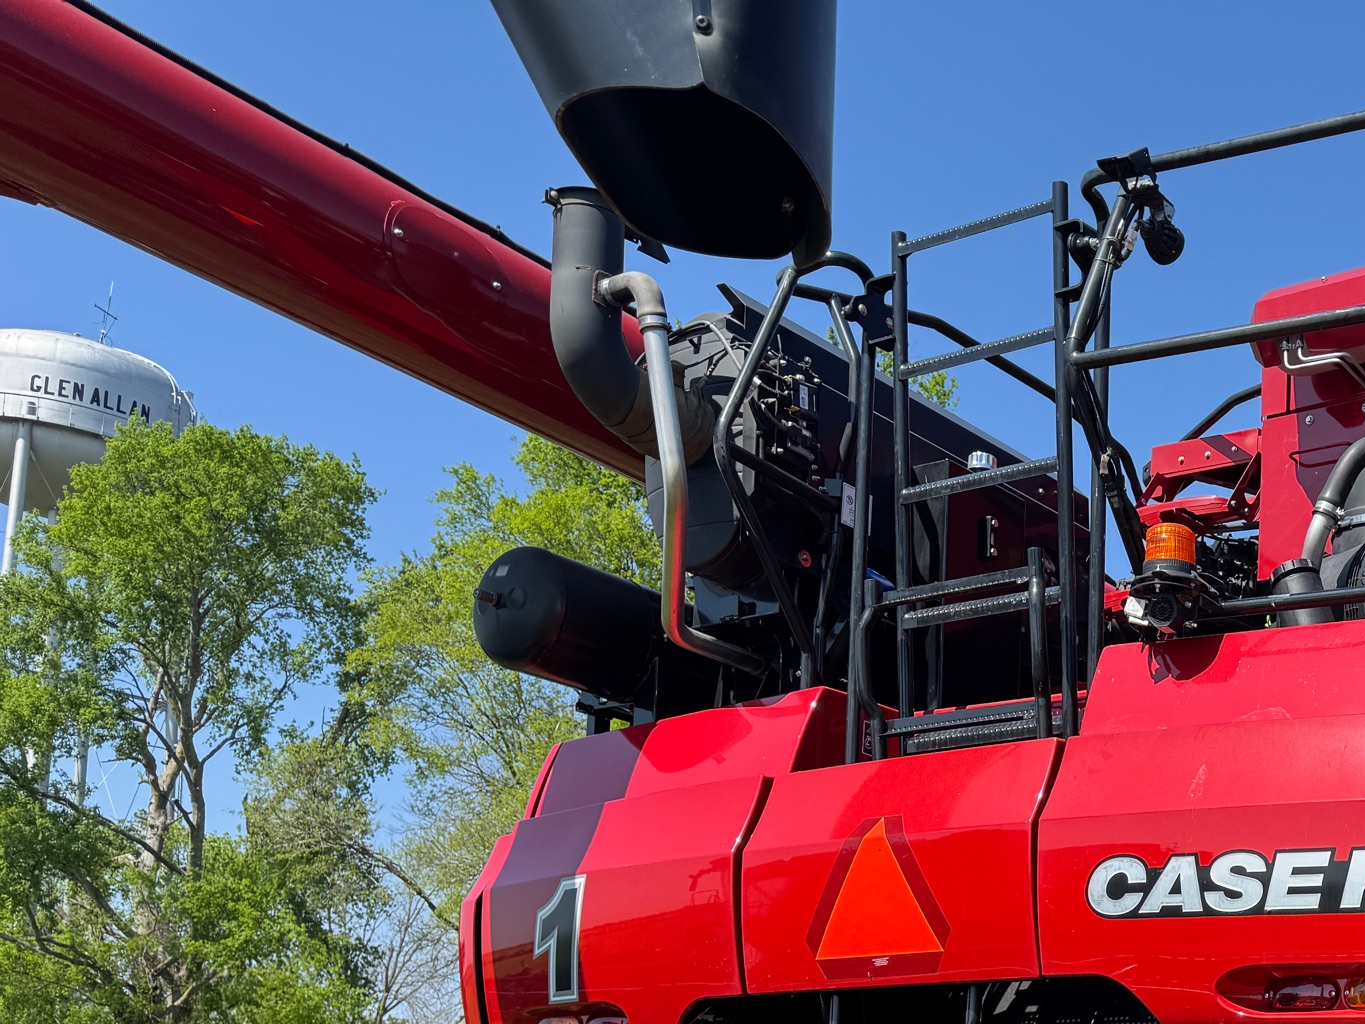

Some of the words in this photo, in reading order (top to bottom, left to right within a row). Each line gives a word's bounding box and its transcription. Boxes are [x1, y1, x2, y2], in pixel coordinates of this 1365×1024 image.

[29, 374, 85, 402] GLEN
[90, 387, 151, 425] ALLAN
[1085, 849, 1333, 917] CASE
[533, 873, 587, 1005] 1
